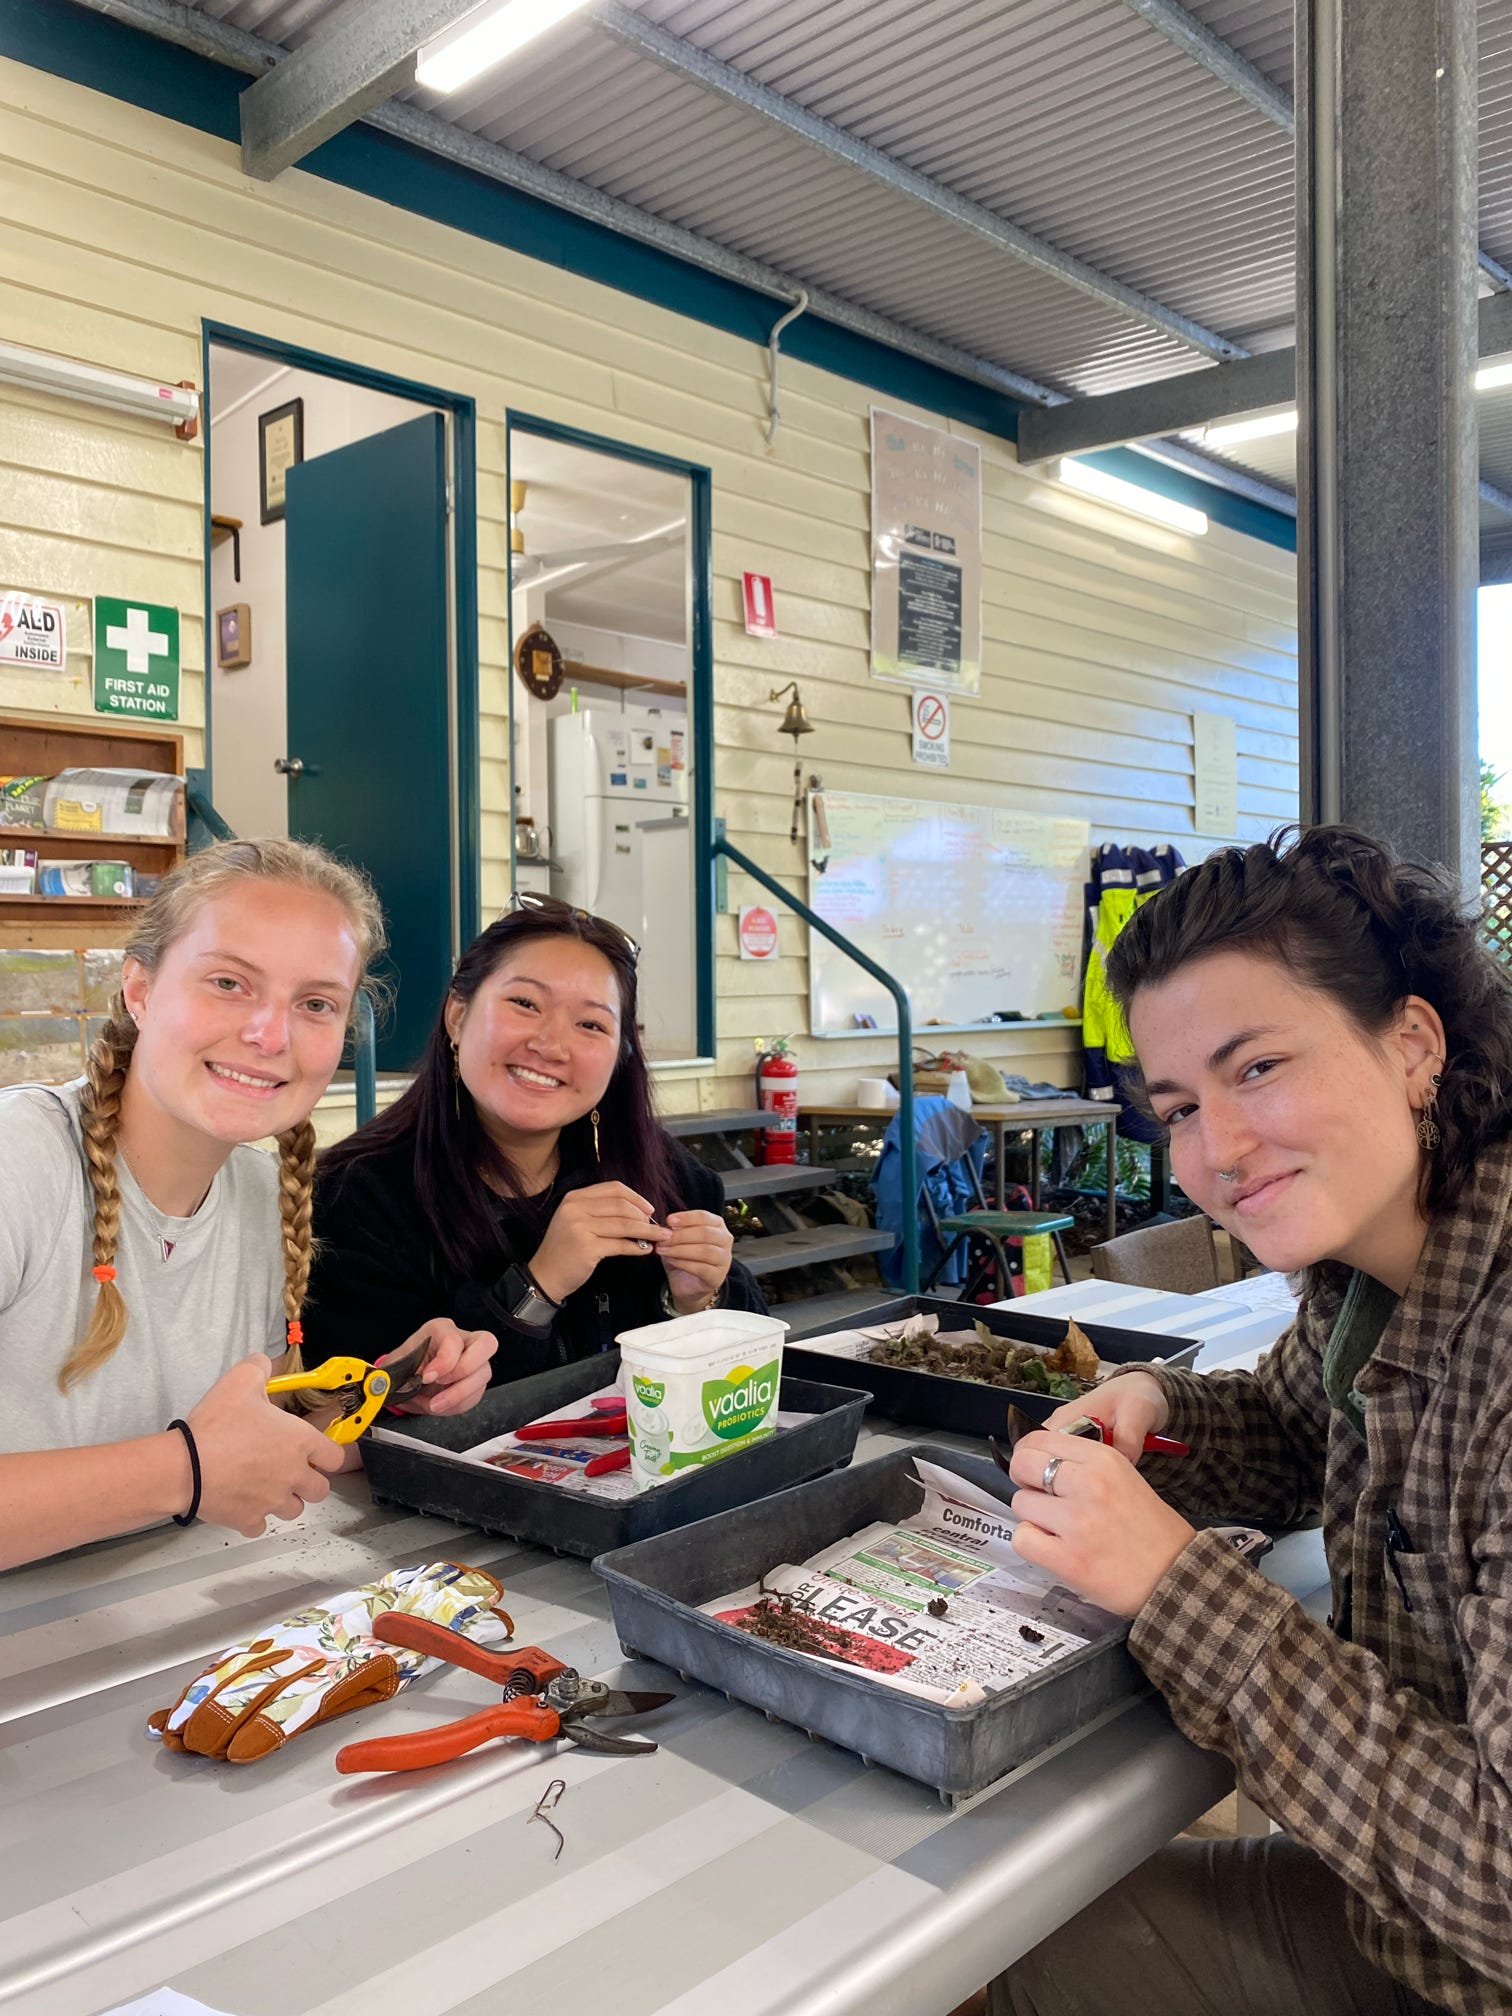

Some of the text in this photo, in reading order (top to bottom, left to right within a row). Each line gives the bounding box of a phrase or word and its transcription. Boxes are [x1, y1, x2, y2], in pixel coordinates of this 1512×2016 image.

[15, 645, 58, 662] INSIDE
[105, 677, 170, 697] FIRST AID
[109, 695, 166, 713] STATION
[634, 1383, 662, 1400] vaalia
[709, 1379, 772, 1419] vaalia
[717, 1406, 766, 1430] PROBIOTICS
[701, 1448, 721, 1461] BOOST
[942, 1508, 1014, 1541] Comforta
[933, 1527, 989, 1546] central
[795, 1587, 938, 1650] LEASE
